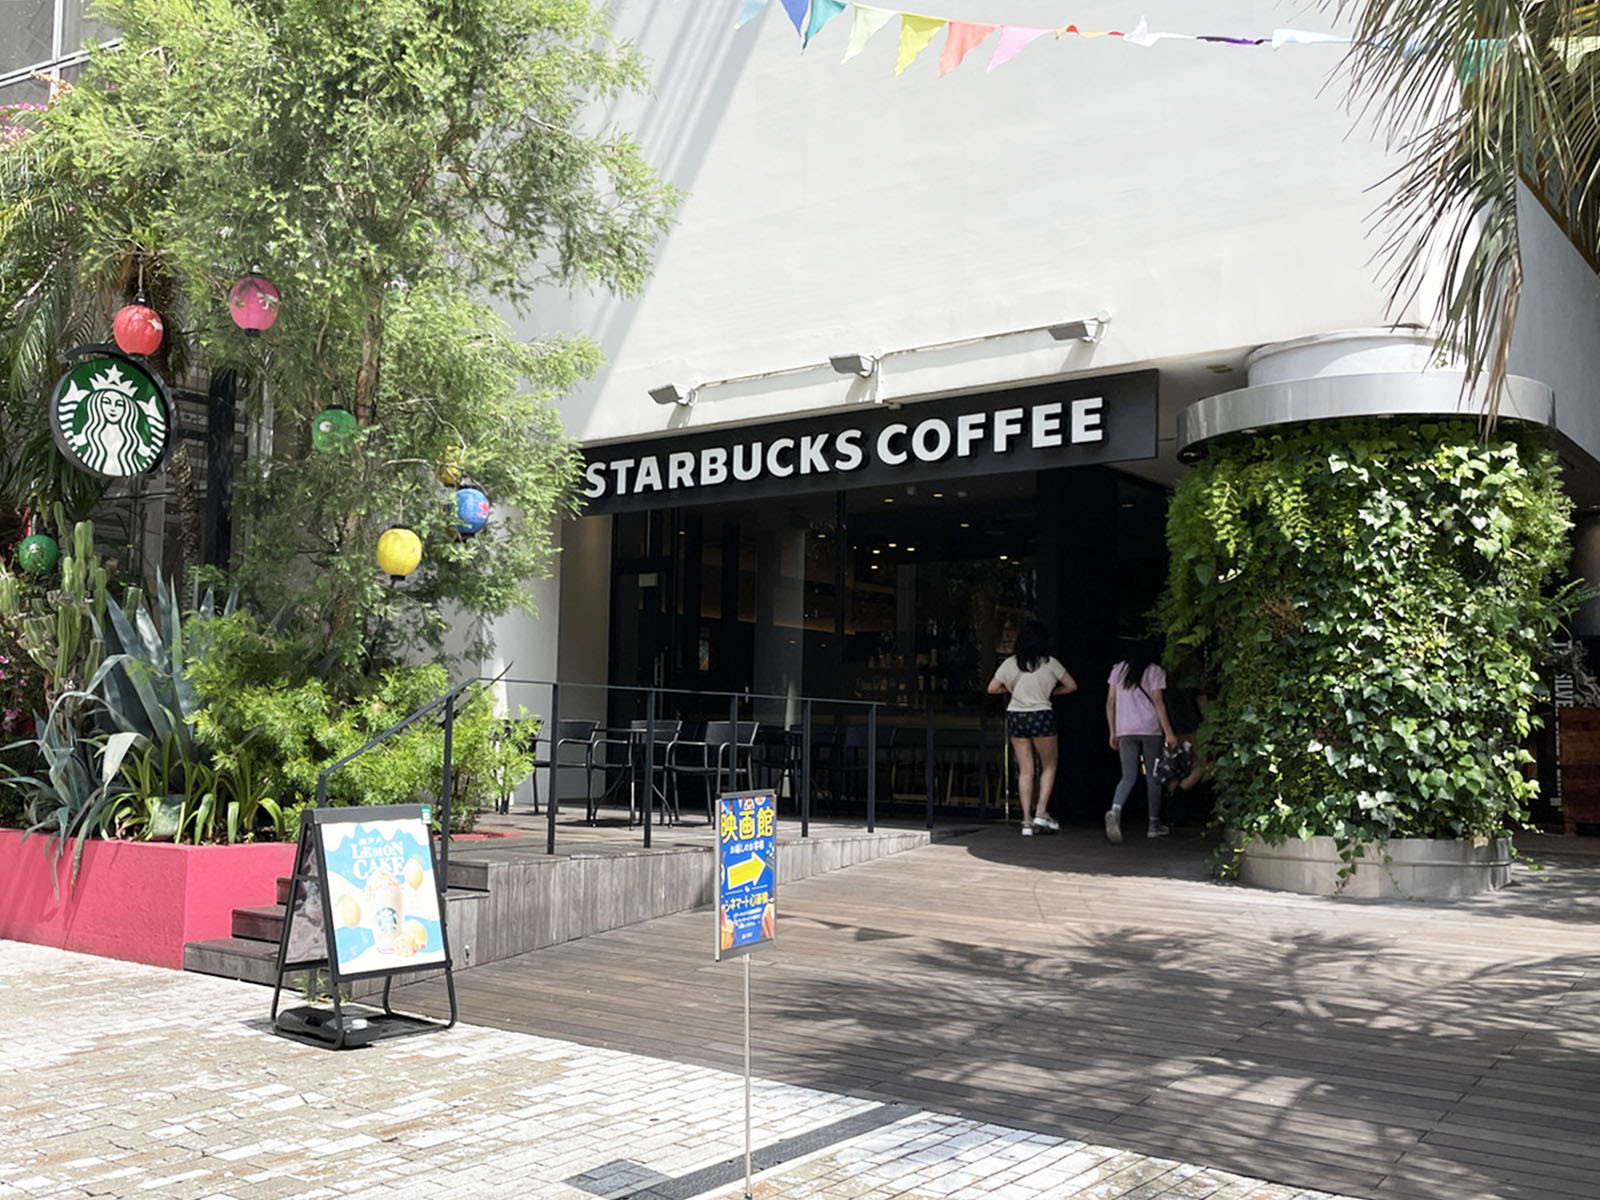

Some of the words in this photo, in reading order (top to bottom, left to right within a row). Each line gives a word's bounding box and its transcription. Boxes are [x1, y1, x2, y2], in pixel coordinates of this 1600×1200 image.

[584, 429, 864, 499] STARBUCKS
[876, 396, 1104, 466] COFFEE
[720, 806, 775, 844] 映画館
[351, 840, 404, 860] LEMON
[351, 855, 406, 880] CAKE
